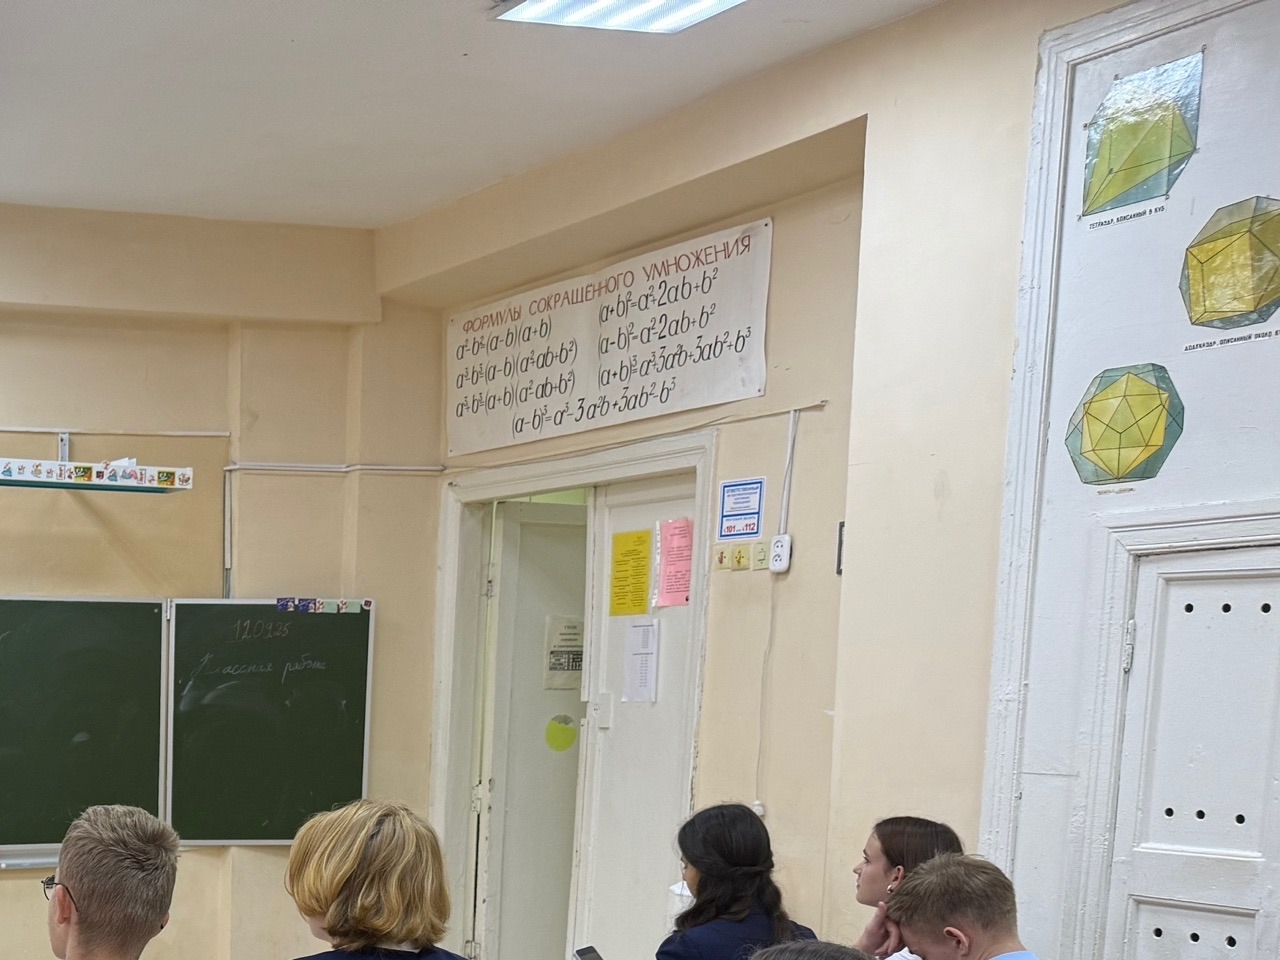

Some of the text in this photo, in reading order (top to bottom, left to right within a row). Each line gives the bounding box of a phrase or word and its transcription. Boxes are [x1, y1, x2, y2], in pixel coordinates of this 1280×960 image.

[462, 305, 521, 334] ФОРМУЛЫ
[642, 234, 751, 282] УМНОЖЕНИЯ
[726, 524, 736, 533] 101
[745, 522, 756, 532] 112
